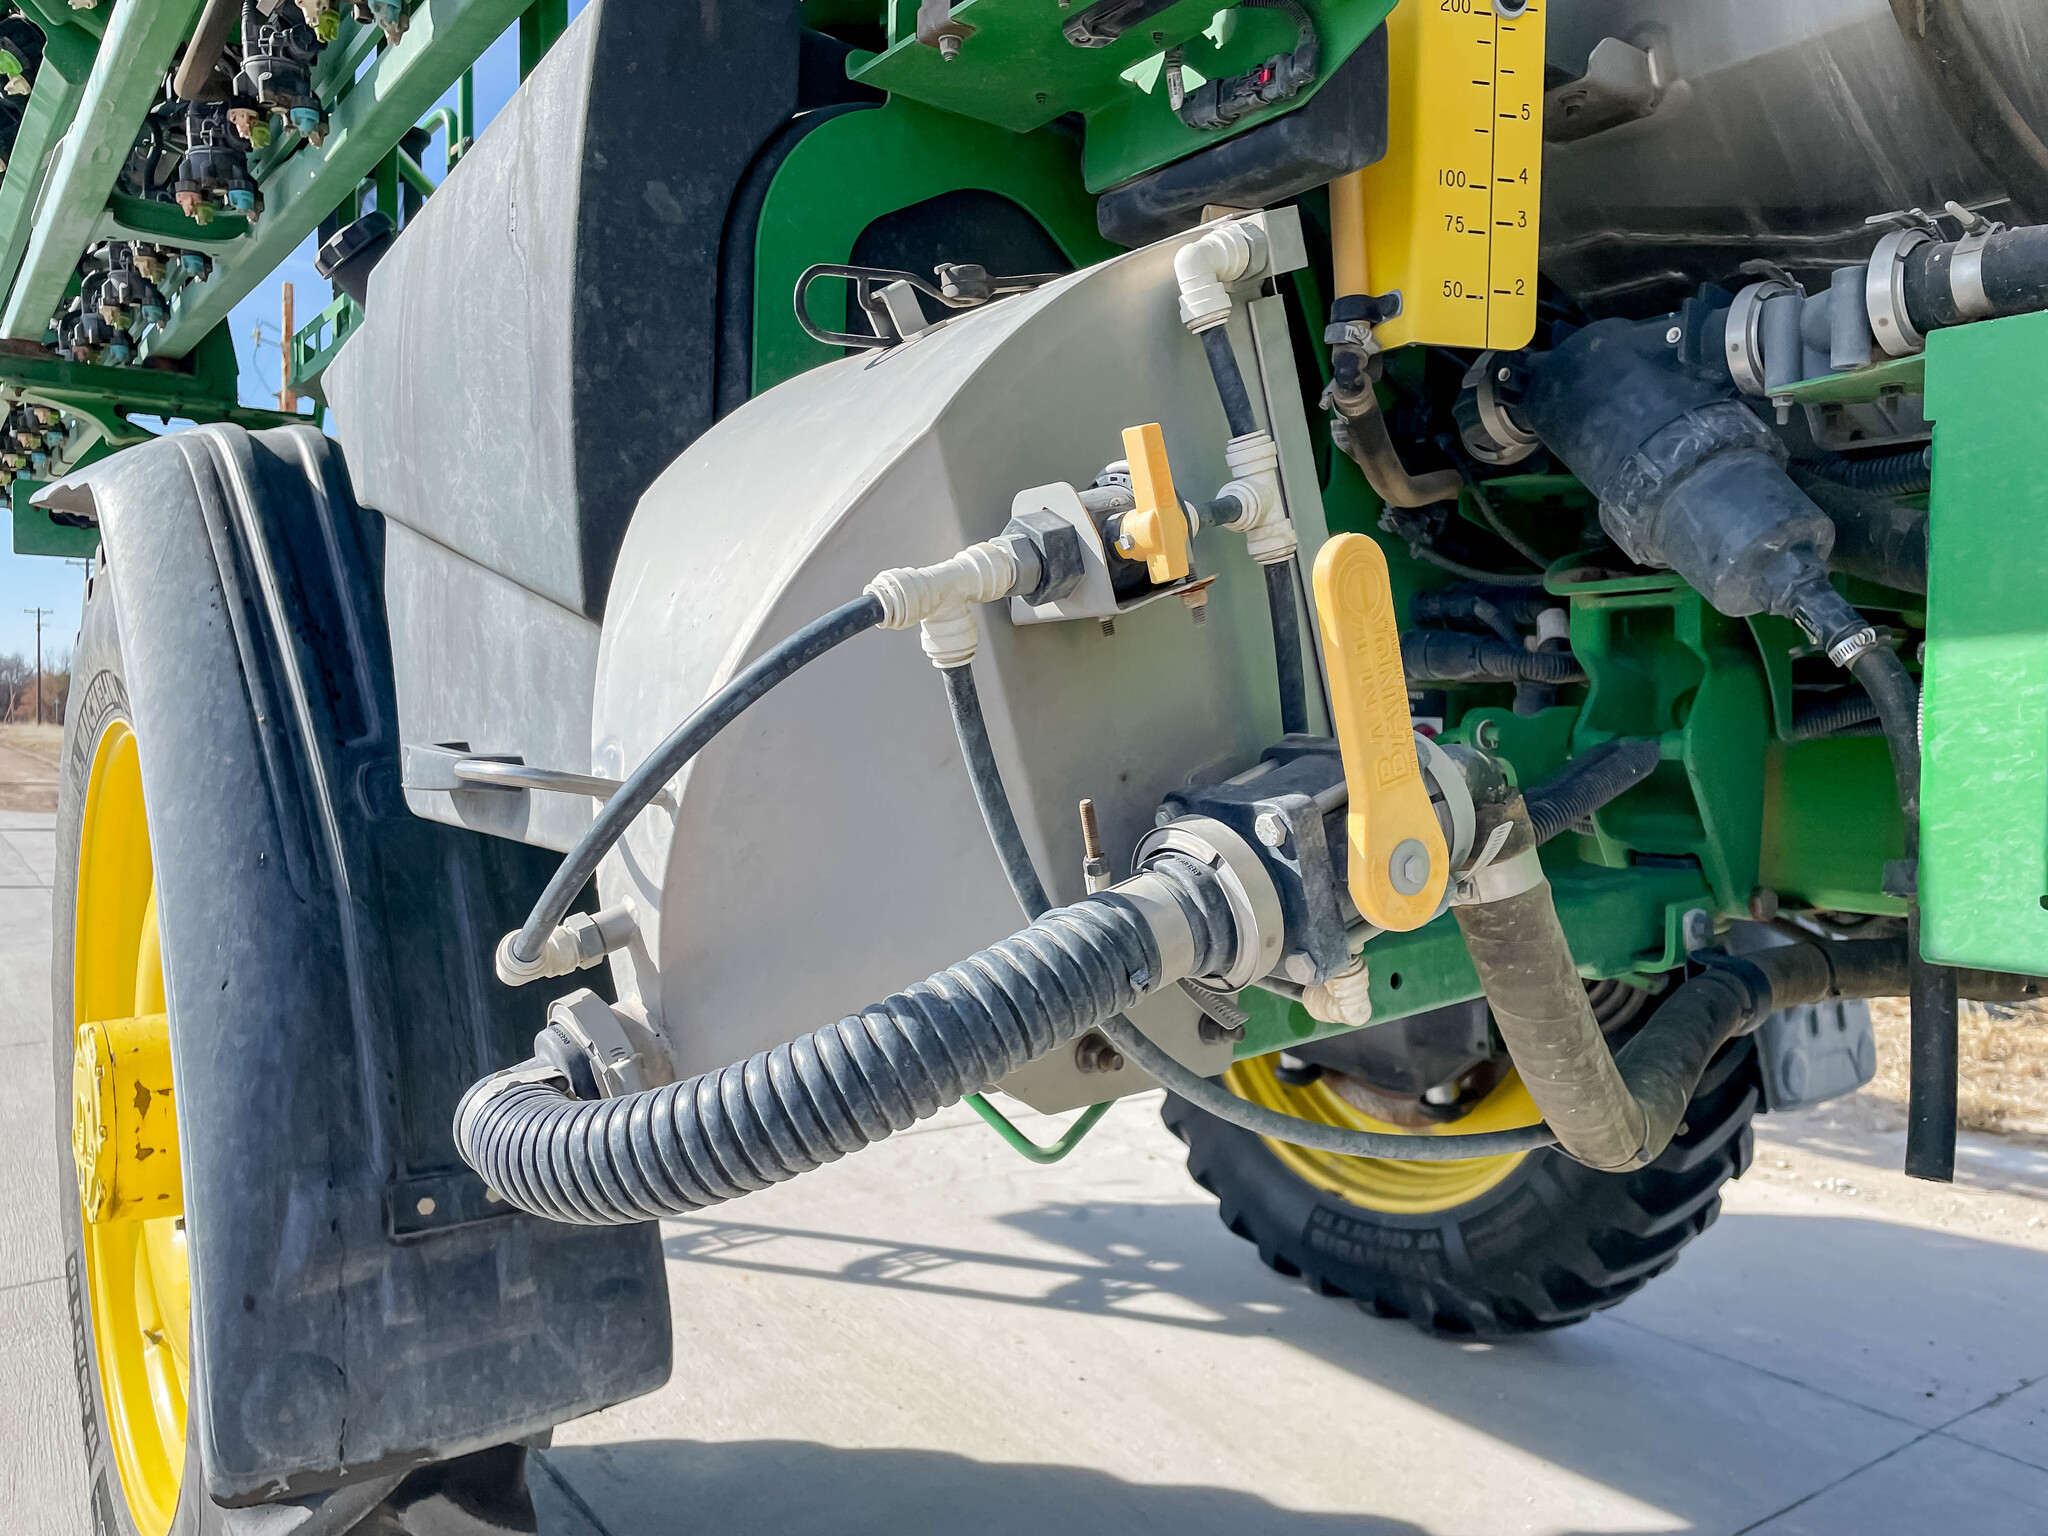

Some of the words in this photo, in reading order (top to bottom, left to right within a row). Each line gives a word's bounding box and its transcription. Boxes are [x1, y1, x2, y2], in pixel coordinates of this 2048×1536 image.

[1520, 103, 1531, 121] 5
[1438, 169, 1466, 188] 100
[1519, 168, 1529, 185] 4
[1444, 215, 1465, 233] 75
[1517, 211, 1528, 228] 3
[1442, 281, 1463, 298] 50
[1515, 279, 1525, 296] 2
[76, 670, 120, 761] MICHELIN
